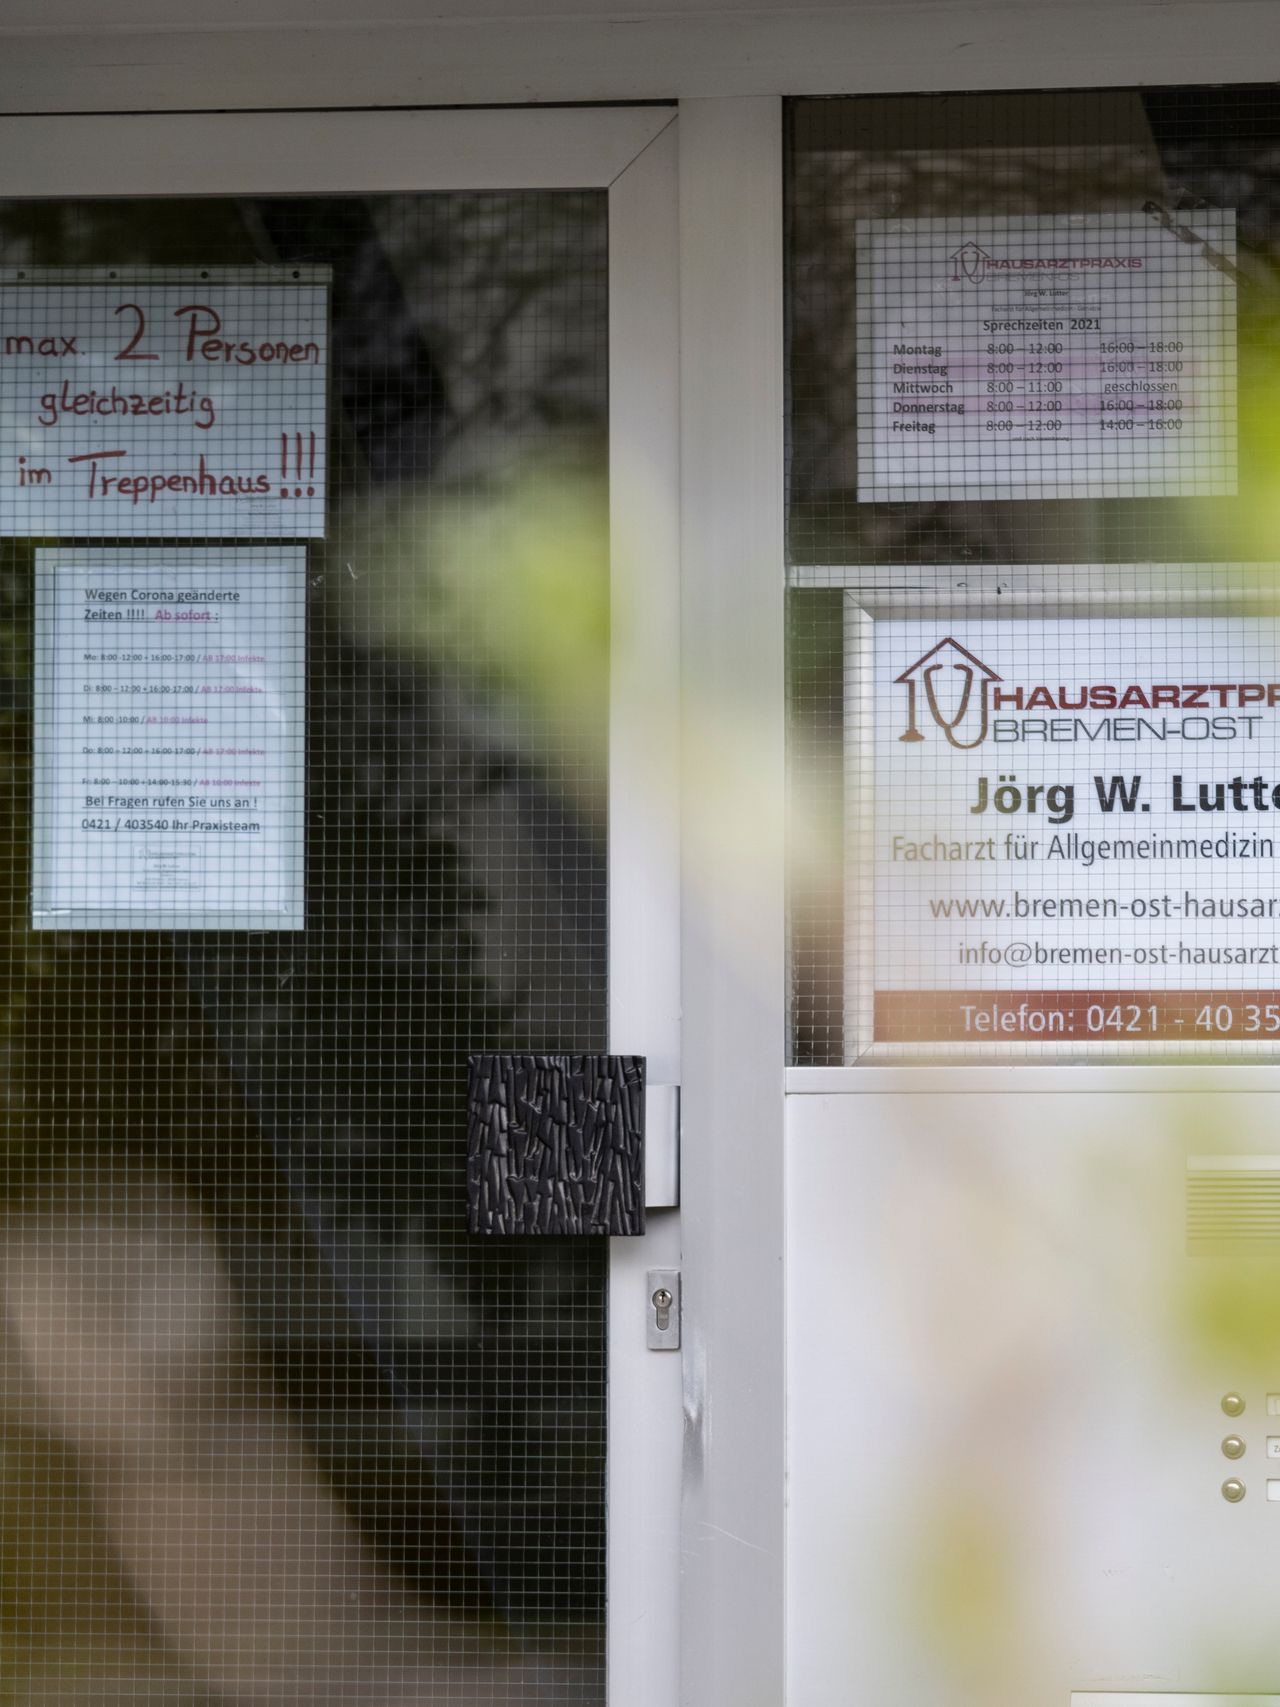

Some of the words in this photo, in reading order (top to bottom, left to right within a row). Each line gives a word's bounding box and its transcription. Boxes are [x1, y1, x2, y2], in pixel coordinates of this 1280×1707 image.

[986, 258, 1142, 270] HAUSARZTPRAXIS
[983, 320, 1063, 333] Sprechzeiten
[1071, 319, 1101, 330] 2021
[114, 304, 160, 360] 2
[174, 304, 319, 365] Personen
[893, 343, 942, 358] Montag
[987, 342, 1014, 354] 8:00
[1028, 342, 1063, 354] 12:00
[1100, 341, 1134, 353] 16:00
[1149, 341, 1183, 353] 18:00
[893, 363, 948, 377] Dienstag
[987, 362, 1014, 374] 8:00
[1028, 362, 1063, 374] 12:00
[1100, 360, 1134, 373] 16:00
[1149, 360, 1183, 373] 18:00
[893, 382, 953, 394] Mittwoch
[987, 381, 1014, 393] 8:00
[1028, 381, 1063, 393] 11:00
[1104, 380, 1177, 394] geschlossen
[38, 379, 215, 429] gleichzeitig
[893, 401, 965, 415] Donnerstag
[986, 401, 1014, 412] 8:00
[1028, 401, 1063, 412] 12:00
[1100, 399, 1134, 411] 16:00
[1149, 399, 1183, 411] 18:00
[893, 421, 936, 434] Freitag
[986, 419, 1014, 431] 8:00
[1028, 419, 1062, 431] 12:00
[1100, 419, 1134, 431] 14:00
[1149, 419, 1183, 431] 16:00
[18, 456, 51, 486] im
[85, 588, 127, 602] Wegen
[131, 589, 174, 600] Corona
[177, 589, 240, 602] geänderte
[84, 609, 122, 620] Zeiten
[155, 609, 171, 620] Ab
[175, 609, 211, 620] sofort
[993, 716, 1263, 742] BREMEN-OST
[85, 796, 104, 807] Bei
[108, 796, 148, 809] Fragen
[153, 796, 185, 807] rufen
[189, 797, 207, 807] Sie
[210, 799, 231, 808] uns
[234, 799, 250, 808] an
[970, 776, 1074, 823] Jörg
[1094, 775, 1150, 812] W.
[82, 818, 111, 830] 0421
[114, 818, 121, 832] /
[124, 819, 168, 830] 403540
[172, 820, 188, 830] Ihr
[192, 820, 260, 831] Praxisteam
[892, 835, 995, 862] Facharzt
[1004, 834, 1039, 860] für
[1048, 833, 1274, 866] Allgemeinmedizin
[960, 1005, 1075, 1033] Telefon:
[1087, 1005, 1159, 1032] 0421
[1197, 1004, 1233, 1031] 40
[1246, 1004, 1280, 1031] 35
